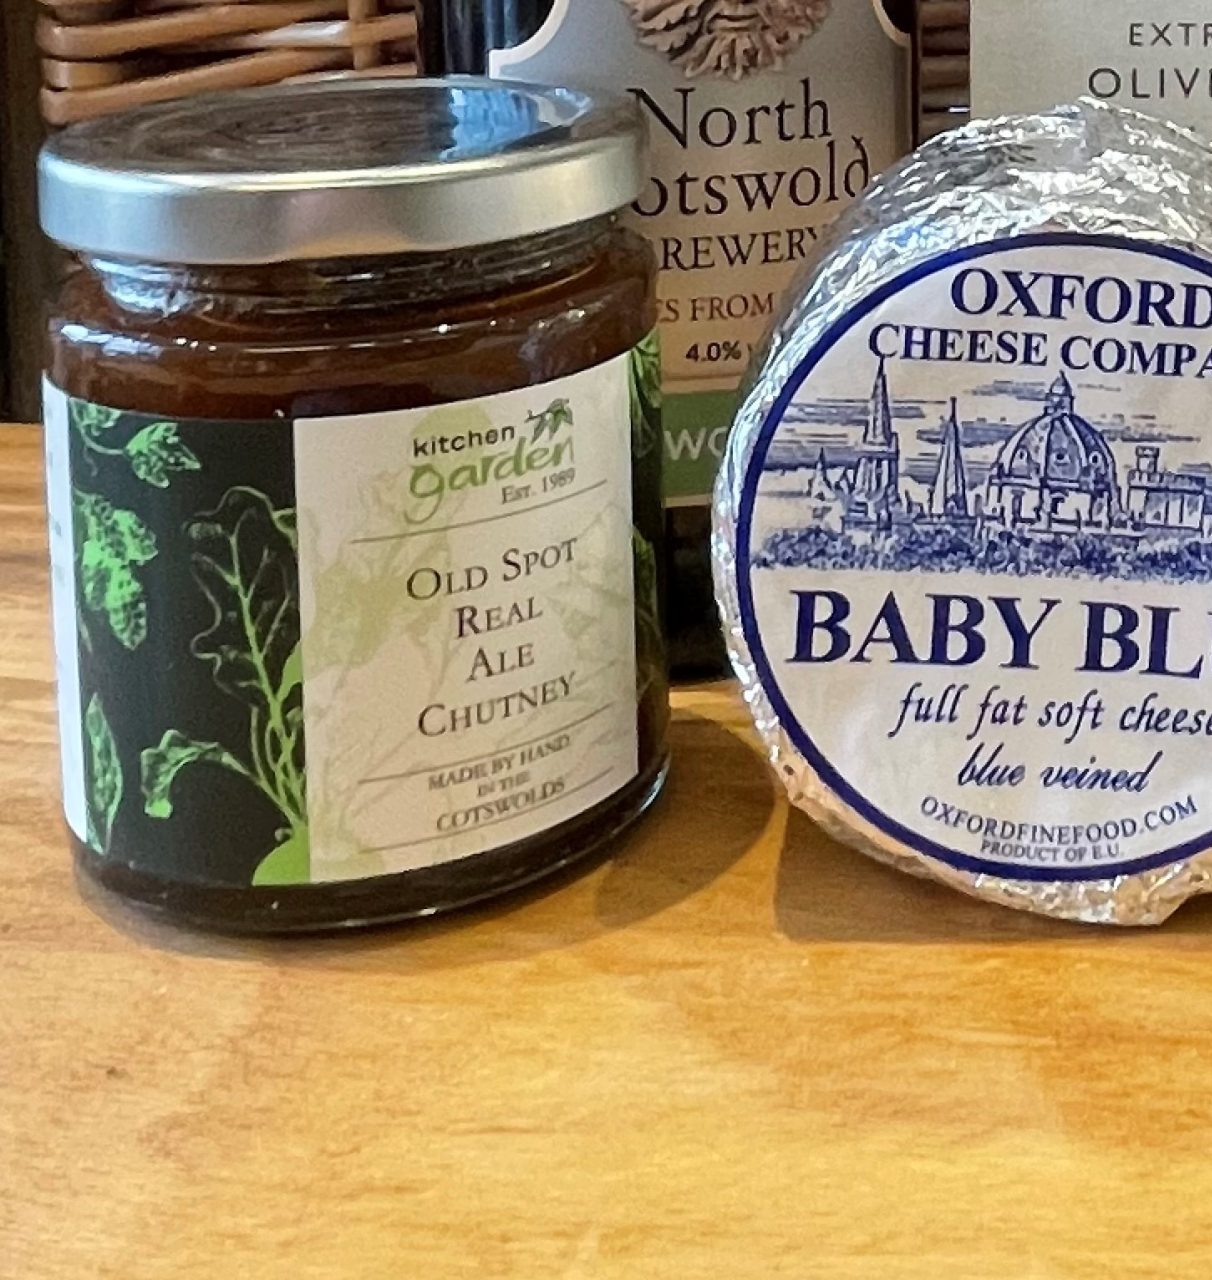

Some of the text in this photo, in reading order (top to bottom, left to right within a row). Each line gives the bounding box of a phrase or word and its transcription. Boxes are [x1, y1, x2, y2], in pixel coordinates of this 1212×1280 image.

[626, 77, 832, 149] North
[631, 134, 869, 216] otswold
[691, 292, 775, 321] FROM
[686, 340, 741, 361] 4.0%
[868, 323, 1048, 366] CHEESE
[413, 425, 514, 458] kitchen
[404, 435, 574, 523] garden
[542, 468, 576, 493] 1989
[407, 537, 577, 600] OLD SPOT
[456, 596, 543, 639] REAL
[785, 588, 1062, 670] BABY
[465, 643, 534, 682] ALE
[418, 671, 576, 737] CHUTNEY
[888, 682, 963, 737] full
[968, 684, 1028, 738] fat
[1038, 687, 1106, 744] soft
[428, 734, 570, 791] MADE BY HAND
[477, 770, 531, 798] IN THE
[957, 742, 1164, 794] blue veined
[436, 779, 565, 832] COTSWOLDS
[920, 794, 1198, 845] OXFORDFINEFOOD.COM
[980, 838, 1060, 861] PRODUCT
[1064, 845, 1088, 862] OF
